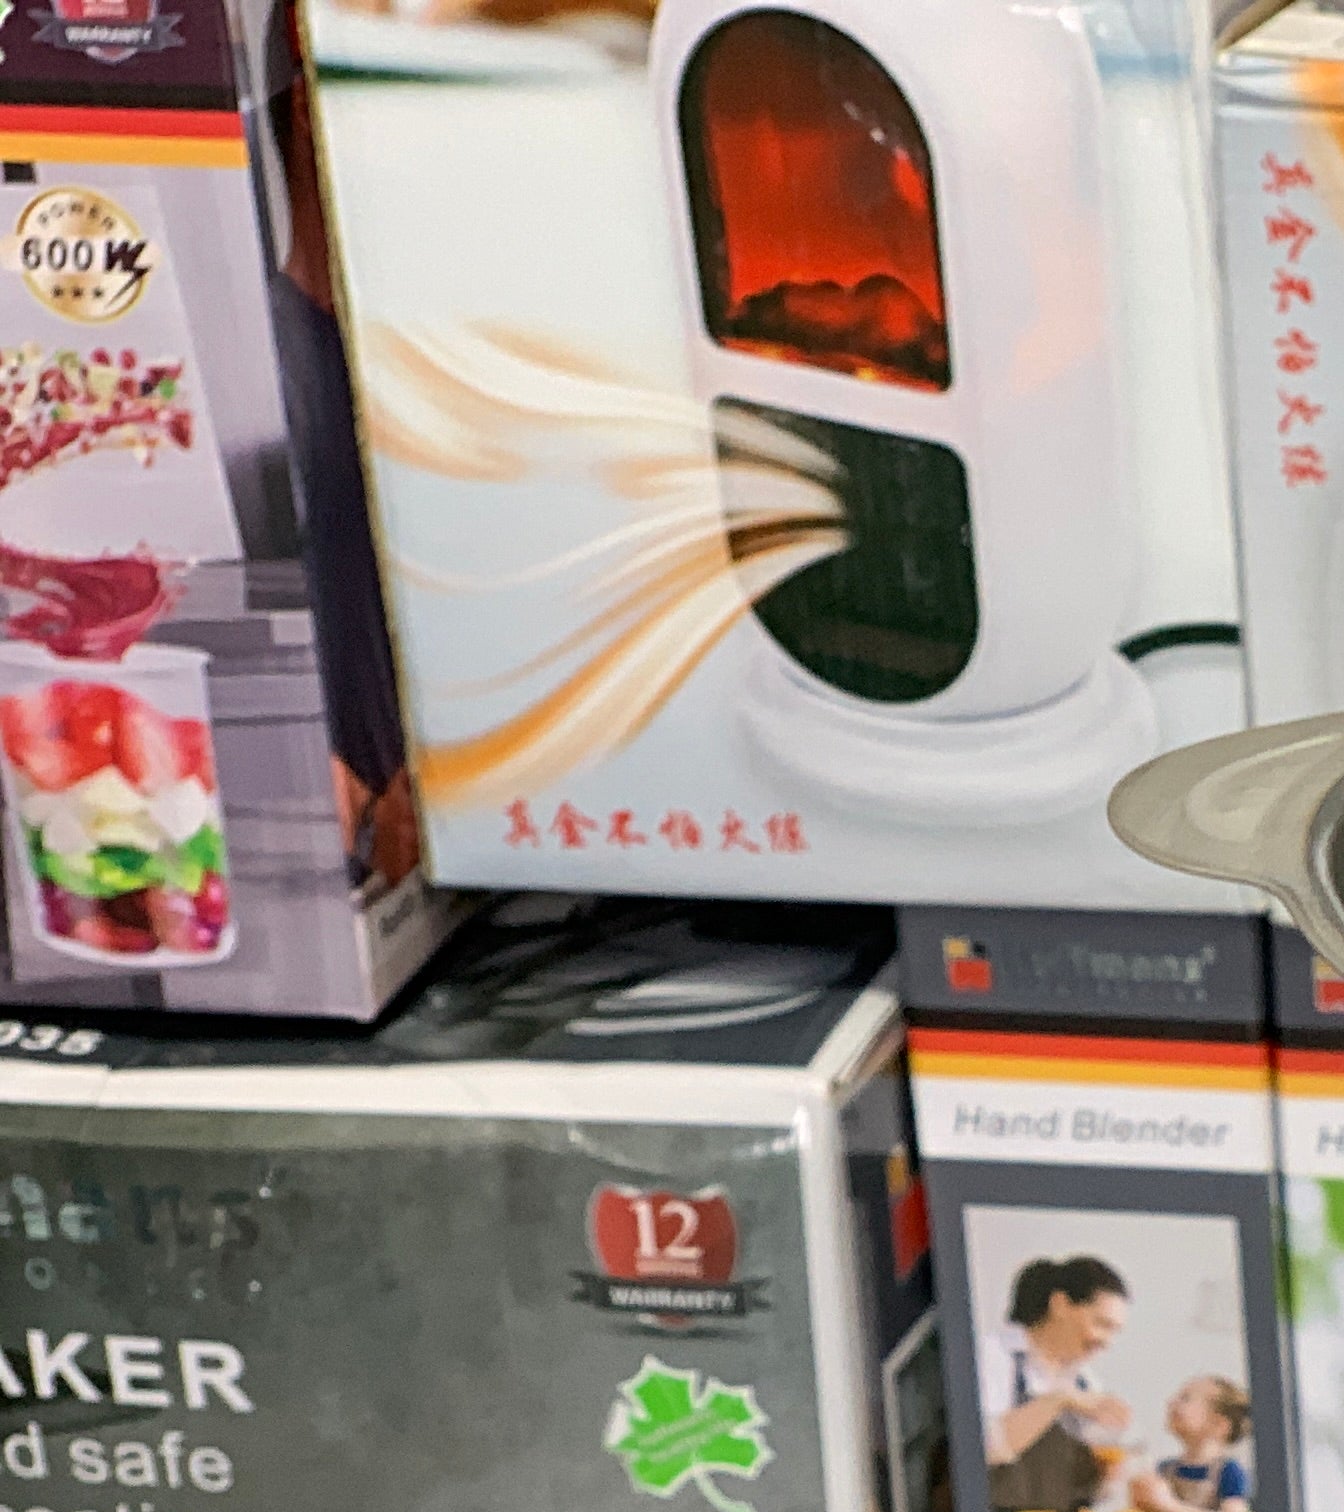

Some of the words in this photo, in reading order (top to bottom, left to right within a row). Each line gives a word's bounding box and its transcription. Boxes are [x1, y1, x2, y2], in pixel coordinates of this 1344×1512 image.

[951, 1105, 1062, 1138] Hand
[1072, 1111, 1231, 1147] Blender
[627, 1200, 702, 1260] 12
[68, 1430, 236, 1493] safe
